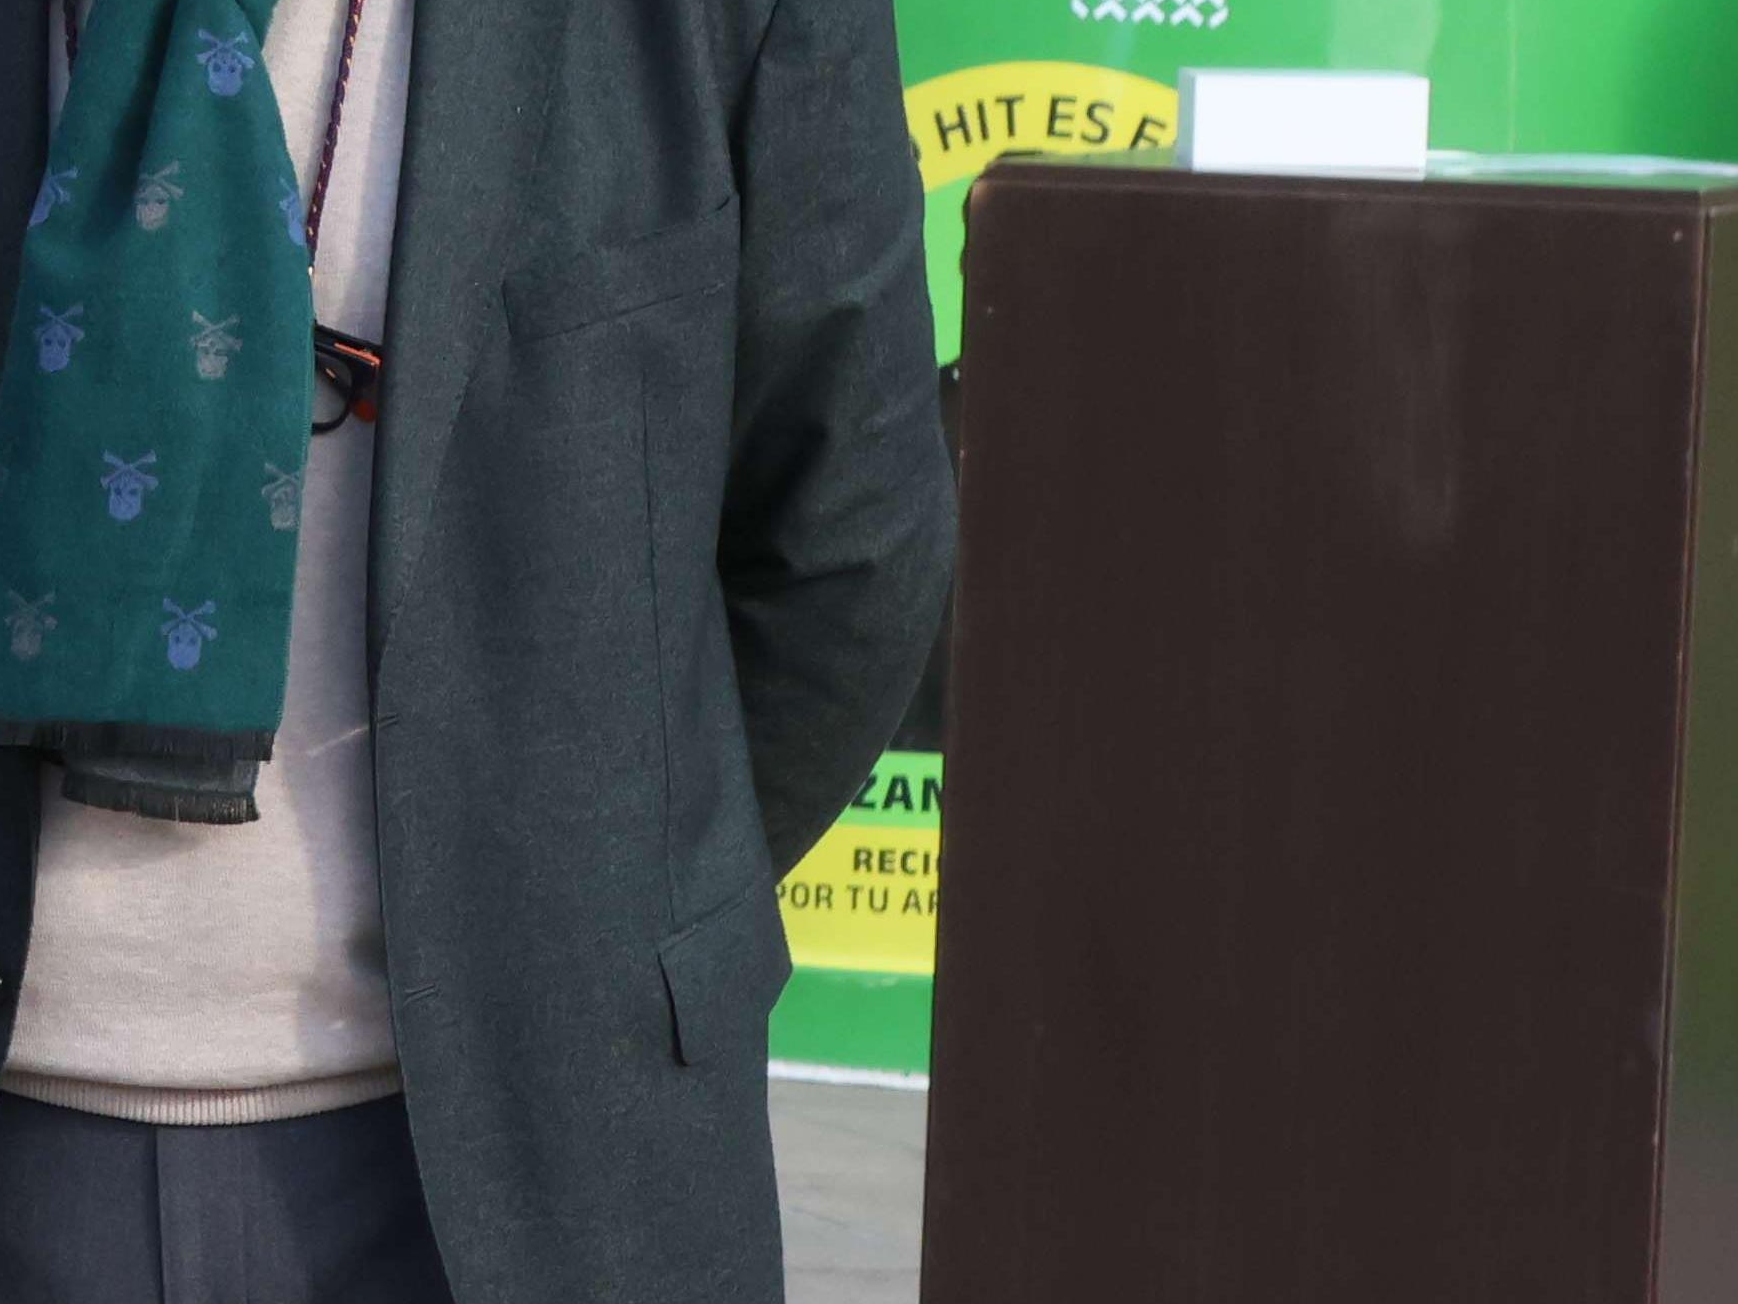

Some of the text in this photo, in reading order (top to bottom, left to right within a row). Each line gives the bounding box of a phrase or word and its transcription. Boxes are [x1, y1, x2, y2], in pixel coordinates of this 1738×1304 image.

[934, 94, 1026, 152] HIT
[1046, 95, 1114, 146] ES
[853, 847, 938, 875] RECI
[847, 885, 889, 914] TU
